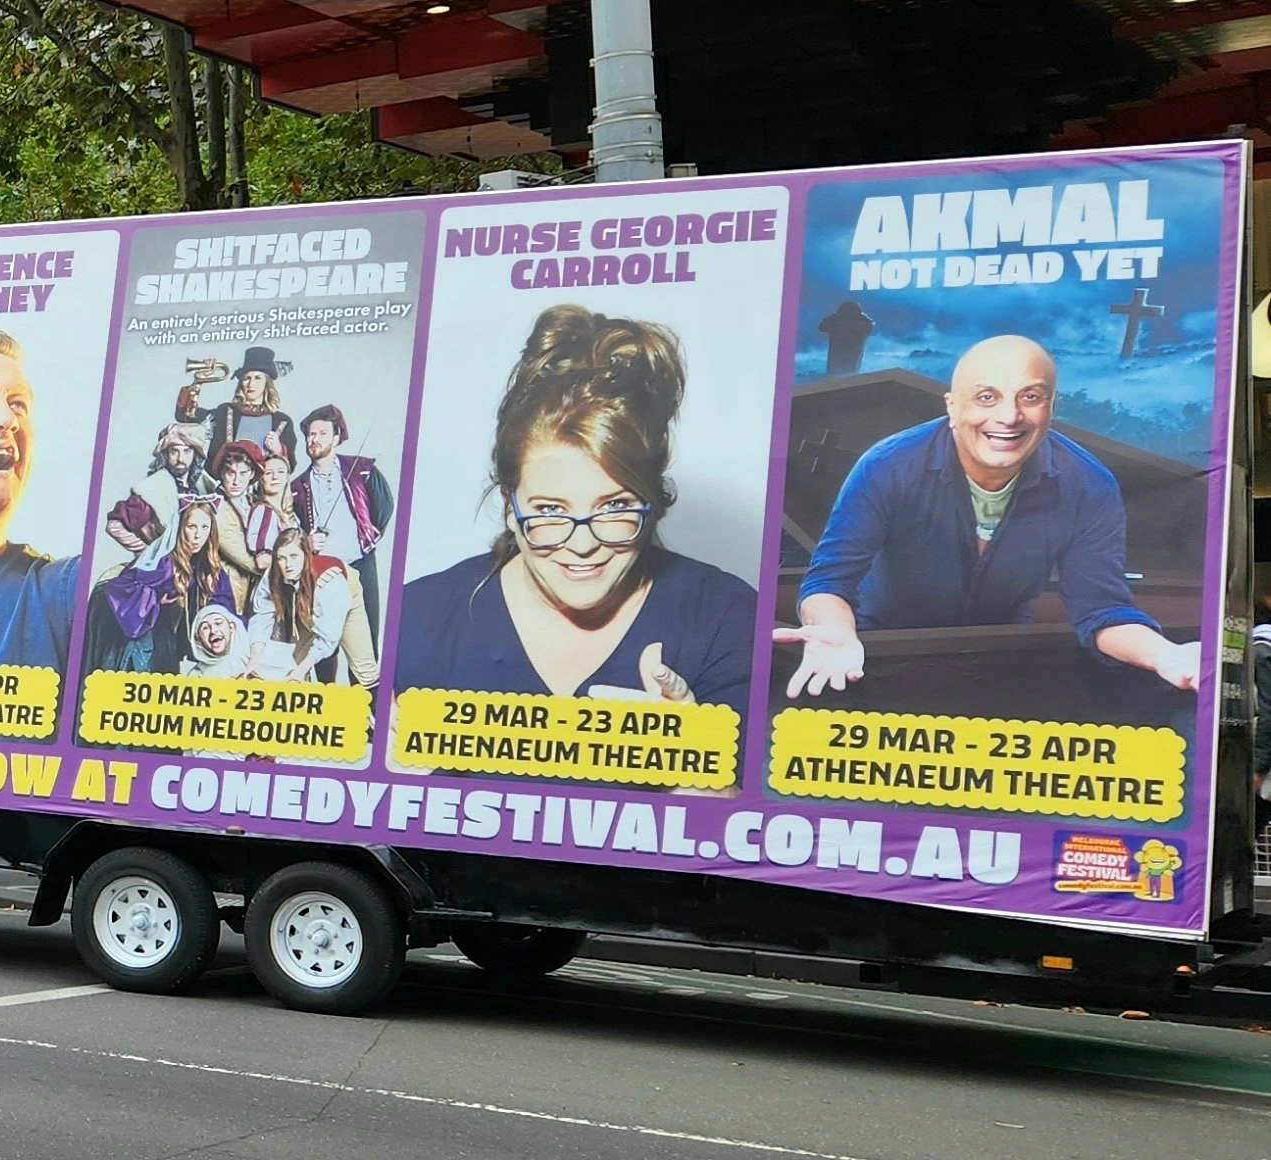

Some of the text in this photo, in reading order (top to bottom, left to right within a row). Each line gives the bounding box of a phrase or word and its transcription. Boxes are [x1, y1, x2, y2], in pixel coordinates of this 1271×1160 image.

[445, 209, 777, 258] NURSE GEORGIE
[850, 180, 1164, 255] AKMAL
[174, 228, 372, 269] SH!TFACED
[850, 246, 1164, 290] NOT DEAD YET
[134, 261, 408, 305] SHAKESPEARE
[511, 251, 696, 290] CARROLL
[128, 301, 412, 331] An entirely serious Shakespeare play
[144, 320, 389, 345] with an entirely sh!t-faced actor.
[122, 683, 152, 703] 30
[158, 684, 212, 708] MAR
[235, 689, 265, 710] 23
[271, 691, 324, 715] APR
[443, 702, 477, 725] 29
[484, 703, 549, 729] MAR
[576, 709, 612, 734] 23
[619, 711, 682, 737] APR
[99, 710, 346, 748] FORUM MELBOURNE
[828, 723, 869, 748] 29
[878, 726, 956, 754] MAR
[988, 733, 1031, 759] 23
[1041, 736, 1116, 764] APR
[405, 731, 721, 774] ATHENAEUM THEATRE
[784, 756, 1165, 806] ATHENAEUM THEATRE
[71, 758, 138, 804] AT
[150, 764, 1022, 884] COMEDYFESTIVAL.COM.AU
[1057, 863, 1132, 880] FESTIVAL
[1063, 851, 1128, 867] COMEDY
